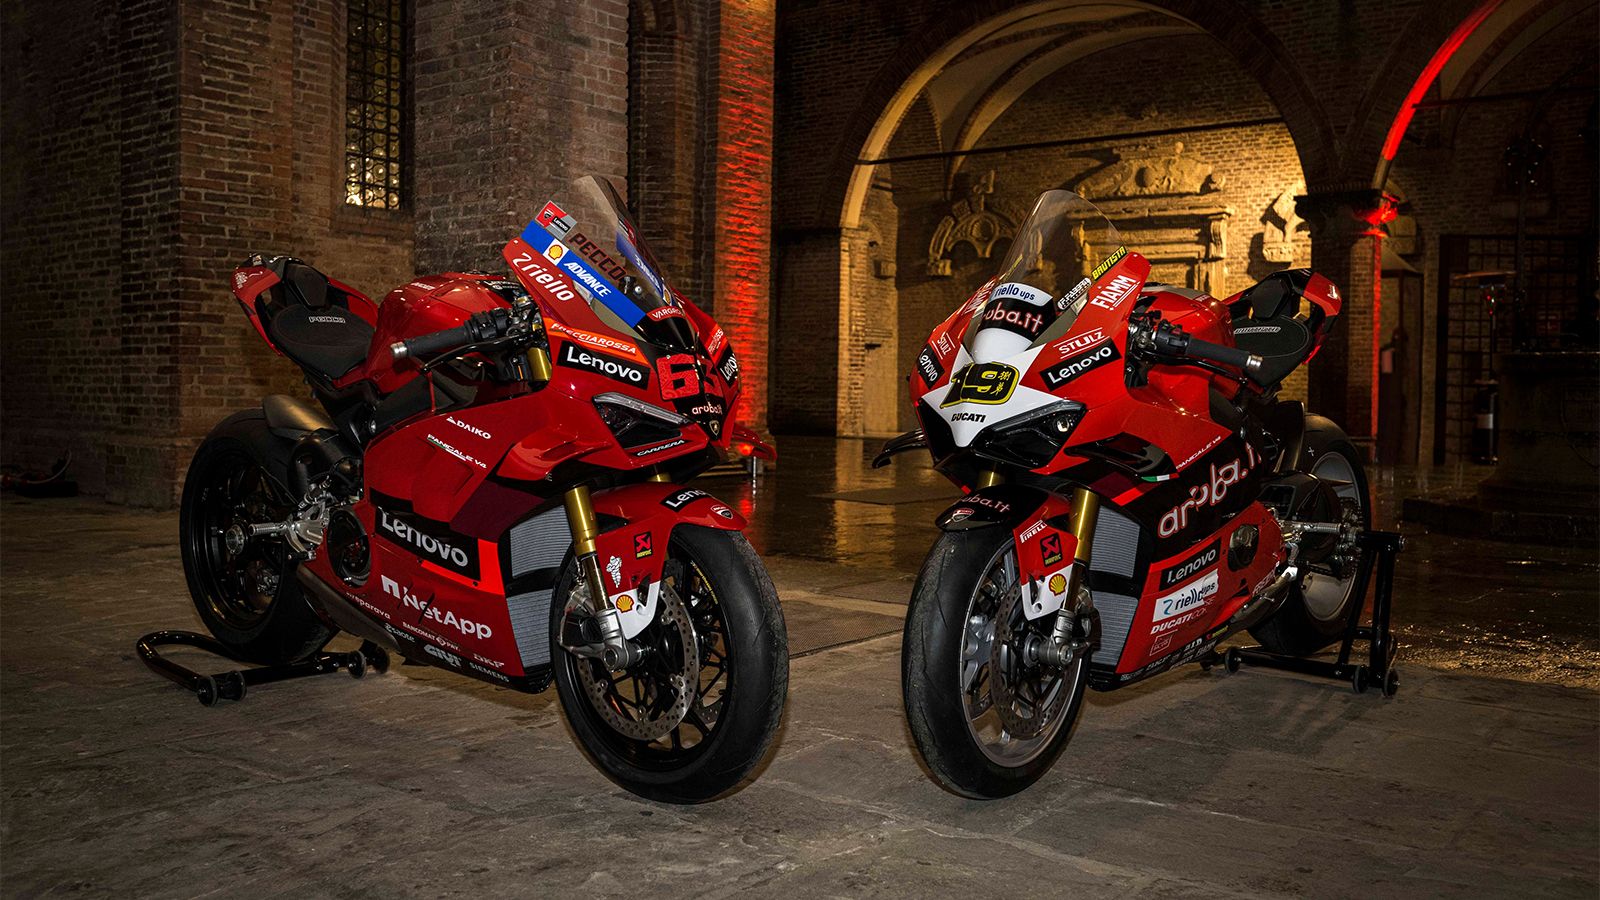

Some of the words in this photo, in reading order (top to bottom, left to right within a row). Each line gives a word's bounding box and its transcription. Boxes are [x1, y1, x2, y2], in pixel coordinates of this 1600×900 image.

[569, 233, 627, 282] PECCO
[1091, 246, 1126, 280] BAUTISTA
[563, 261, 612, 298] ADVANCE
[1019, 290, 1036, 301] ups
[1090, 275, 1137, 310] FIAMM
[983, 303, 1044, 334] uba.it
[550, 322, 637, 354] FRECCIAROSSA
[1058, 331, 1104, 355] STULZ
[566, 346, 642, 382] Lenovo
[656, 353, 723, 400] 63
[720, 353, 737, 381] Lenov
[1048, 347, 1112, 384] Lenovo
[456, 420, 492, 440] DAIKO
[951, 413, 986, 423] DUCATI
[428, 434, 474, 462] PANIGALE
[474, 459, 488, 469] V4
[637, 440, 685, 457] CARRERA
[961, 494, 1011, 513] uba.it
[1157, 440, 1262, 539] aruba.i
[377, 505, 469, 568] Lenovo
[1166, 549, 1216, 584] Lenovo
[402, 586, 493, 640] NetApp
